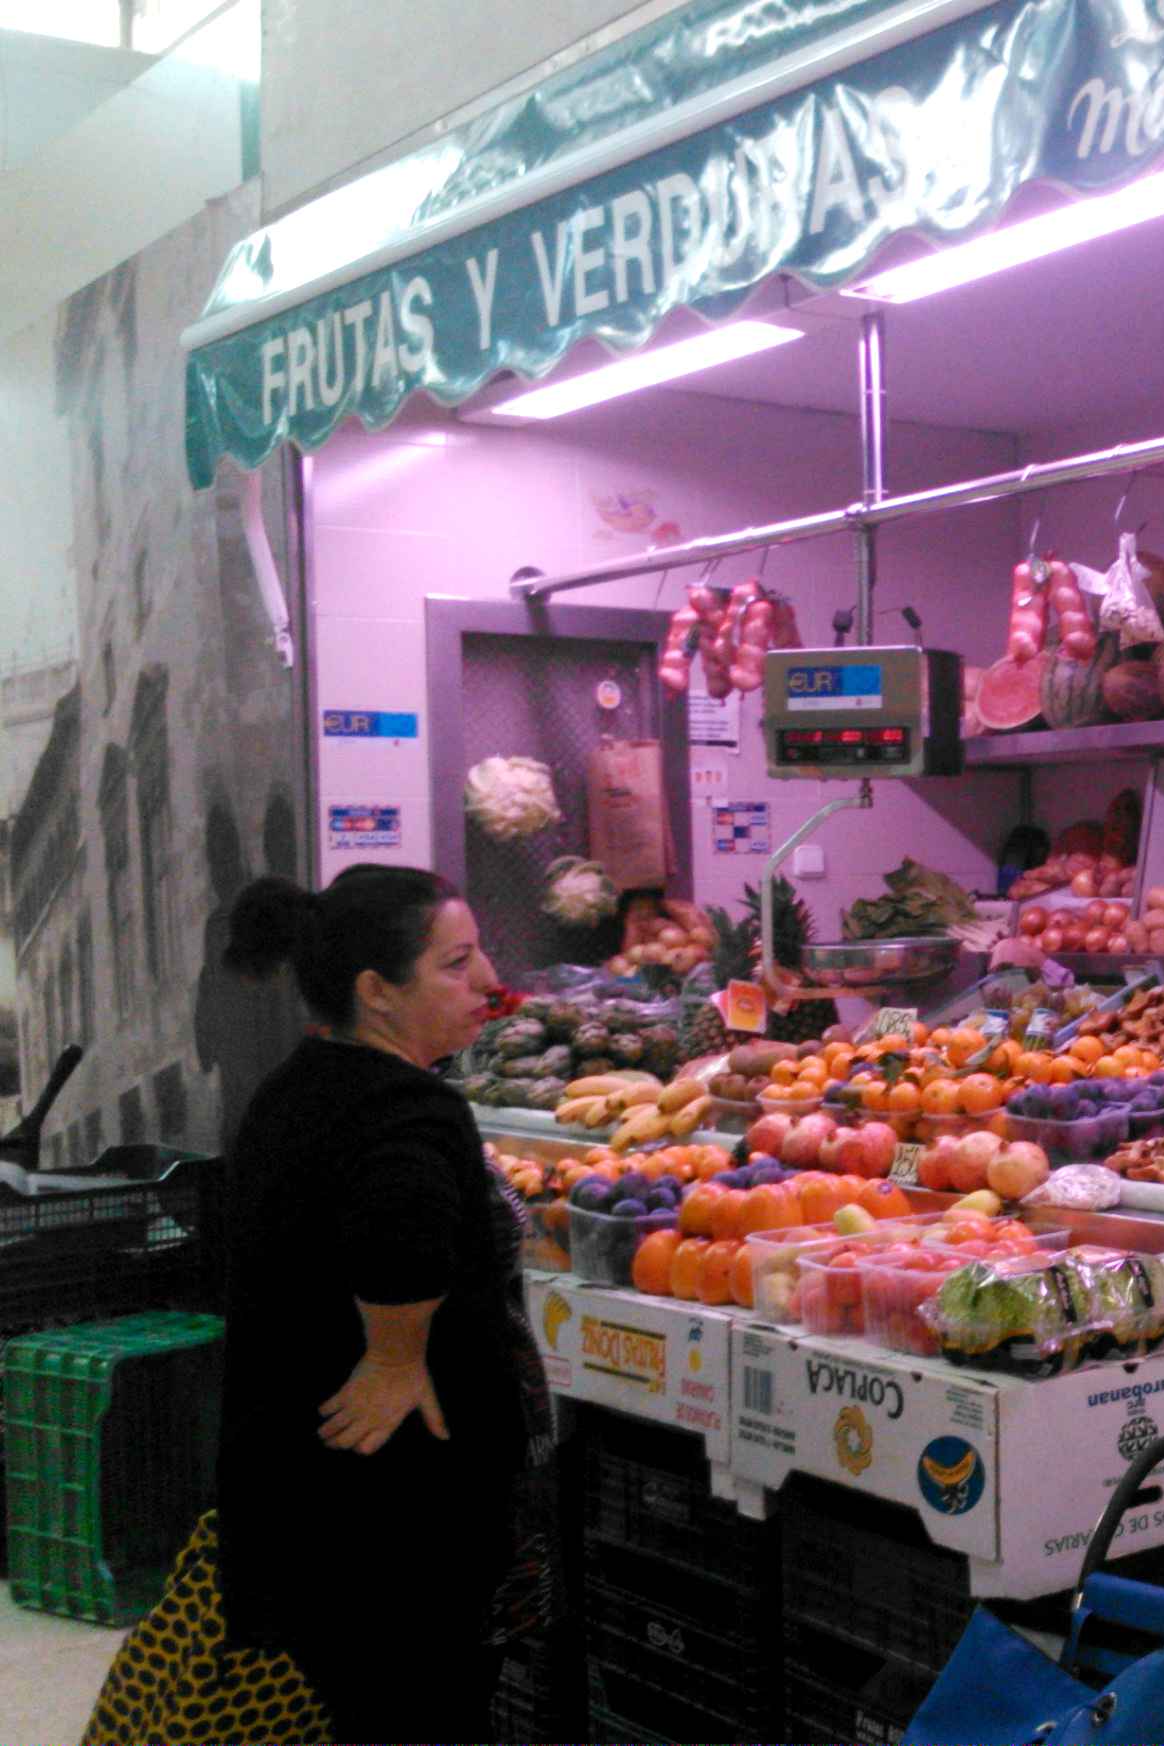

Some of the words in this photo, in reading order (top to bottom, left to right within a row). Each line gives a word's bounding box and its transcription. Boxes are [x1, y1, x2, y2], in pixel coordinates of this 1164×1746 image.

[262, 275, 435, 425] FRUTAS
[465, 248, 499, 351] Y
[531, 86, 911, 327] VERDURAS
[806, 1359, 905, 1420] COPLACA
[1045, 1521, 1125, 1556] CARIAS
[1130, 1517, 1149, 1534] DE
